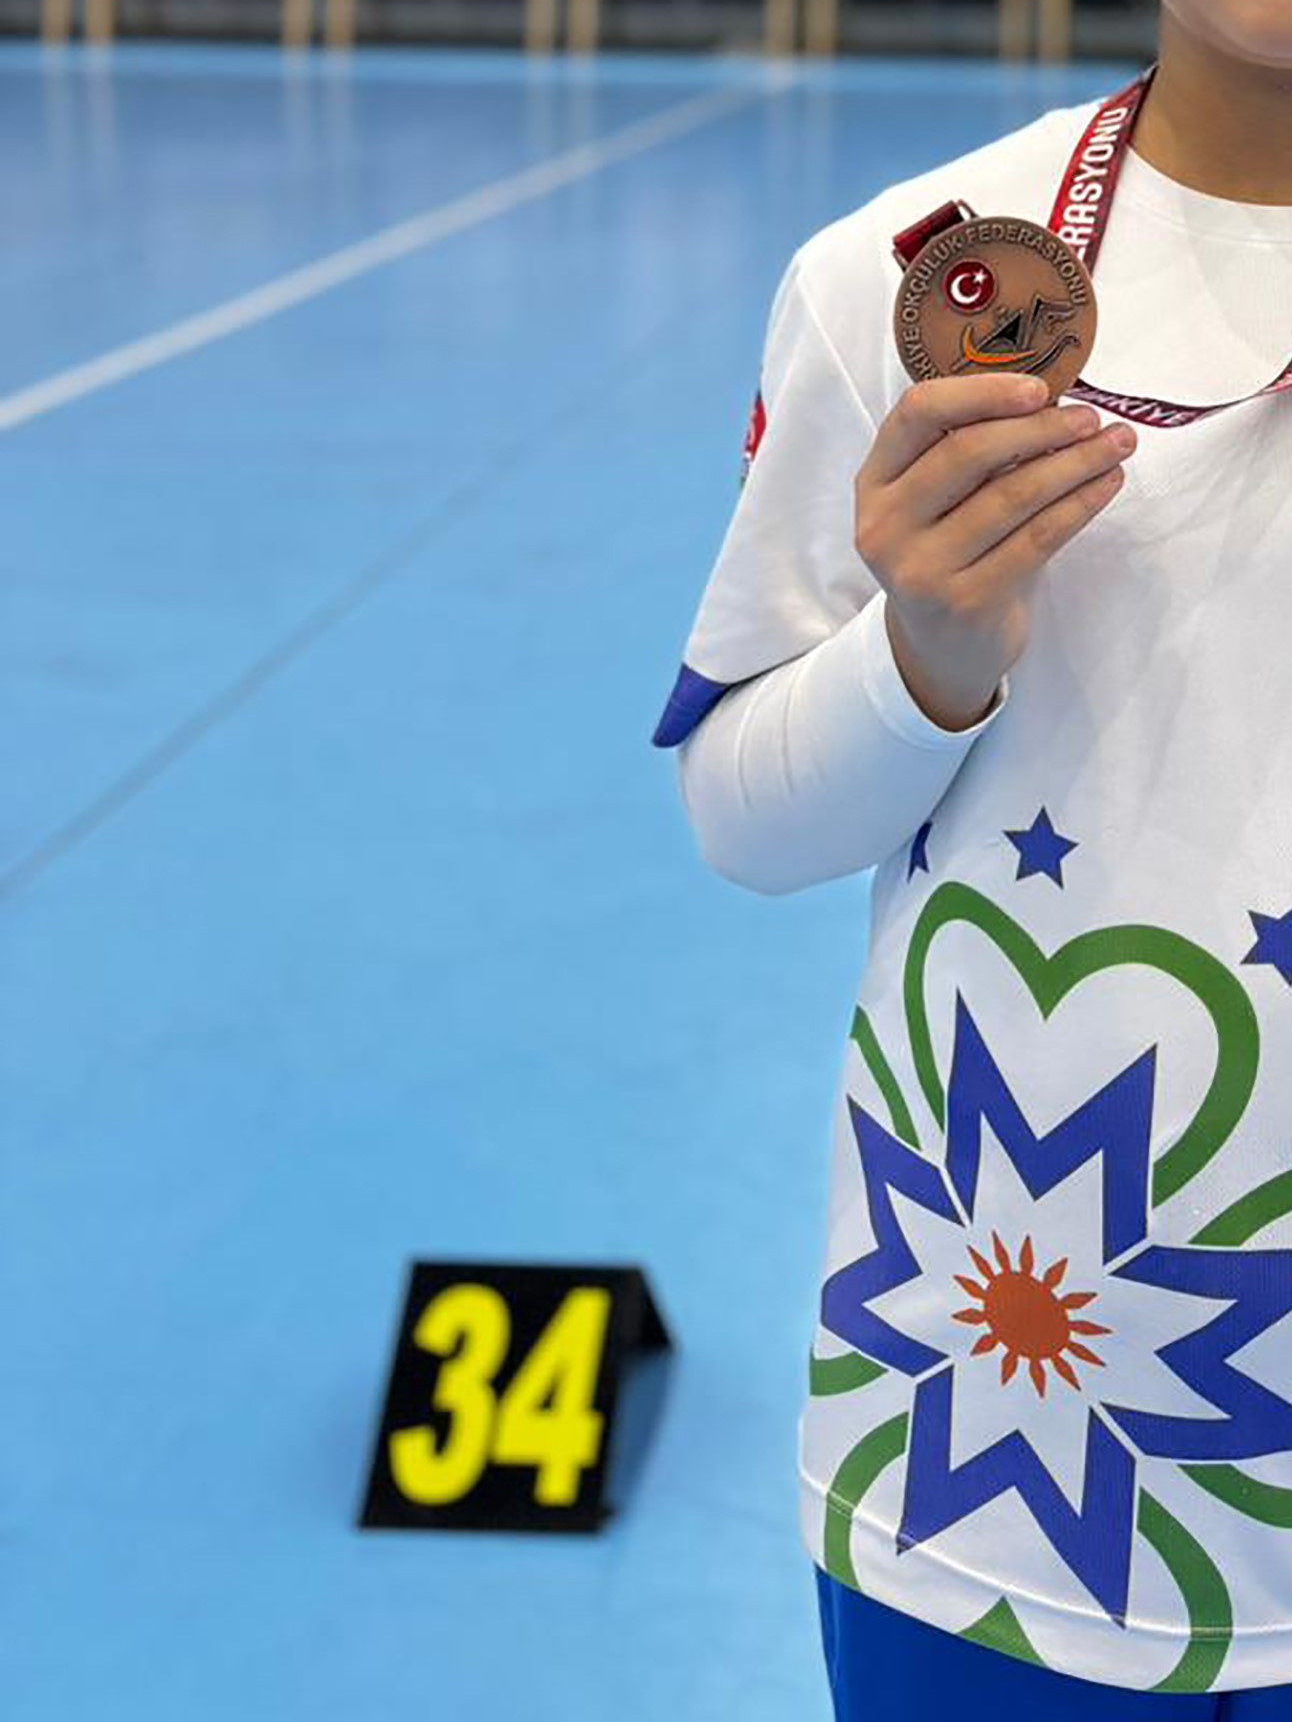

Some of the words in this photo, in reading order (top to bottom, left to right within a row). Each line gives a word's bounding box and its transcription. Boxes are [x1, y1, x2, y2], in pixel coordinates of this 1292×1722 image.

[1058, 106, 1129, 262] RASYONU
[902, 234, 963, 325] OKÇULUK
[966, 223, 1087, 306] FEDERASYONU
[387, 1281, 612, 1507] 34
